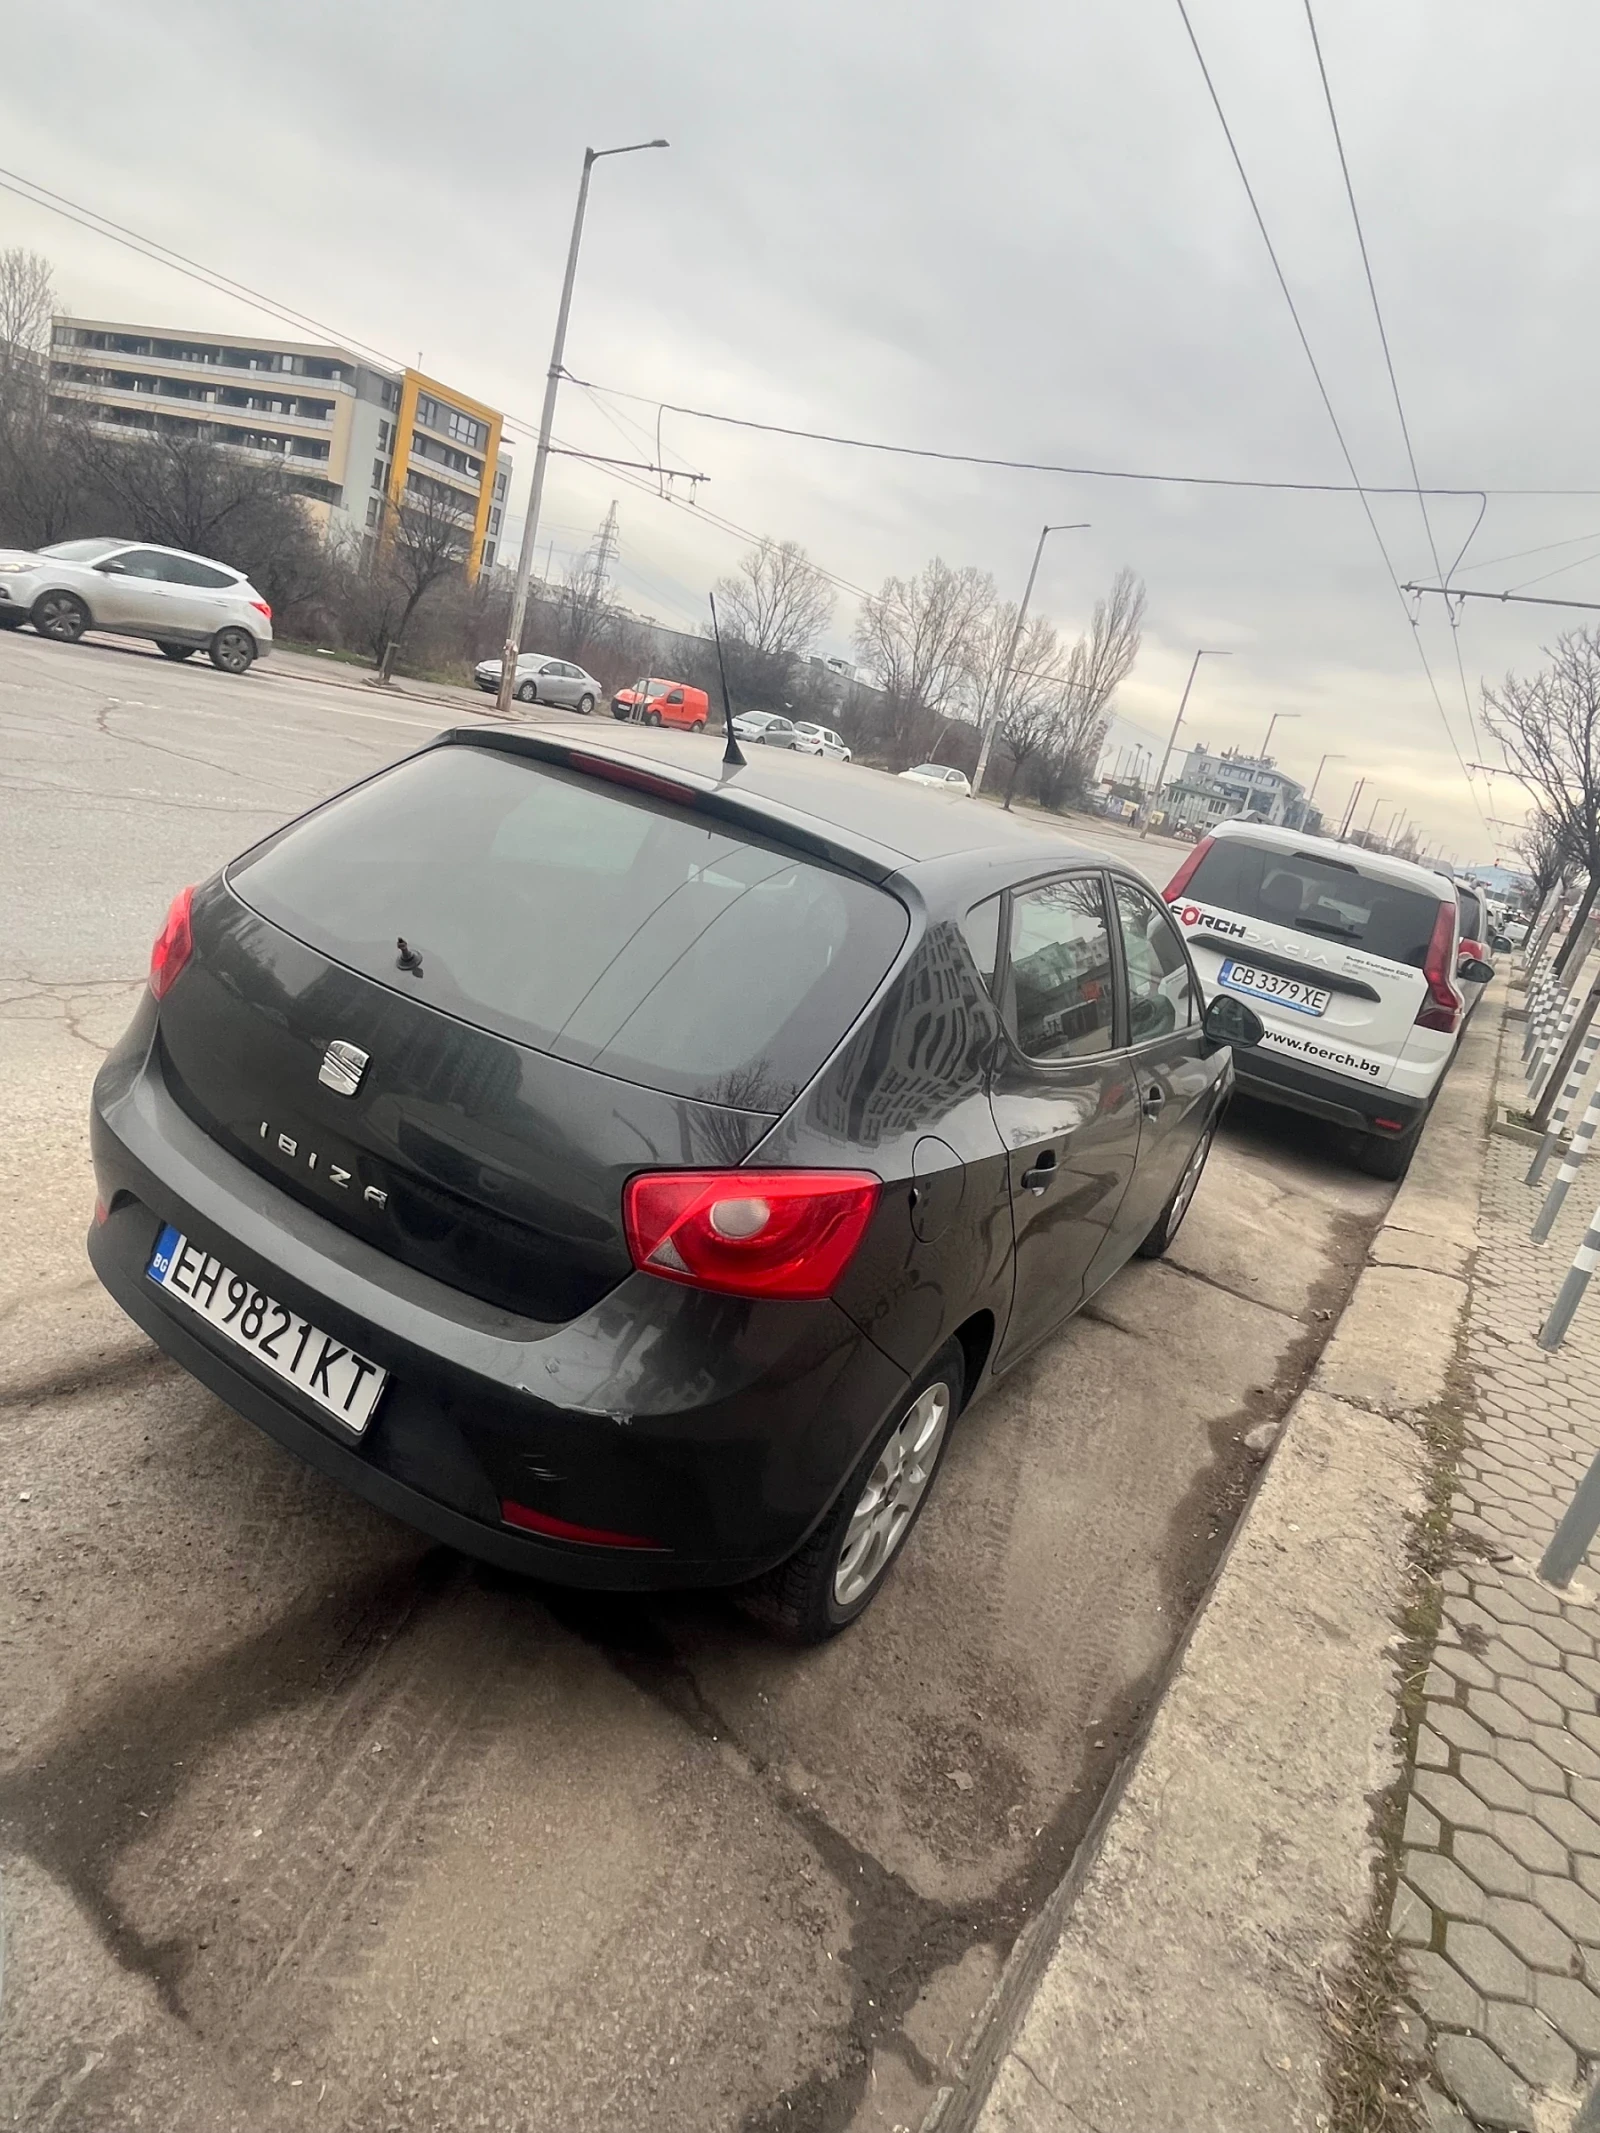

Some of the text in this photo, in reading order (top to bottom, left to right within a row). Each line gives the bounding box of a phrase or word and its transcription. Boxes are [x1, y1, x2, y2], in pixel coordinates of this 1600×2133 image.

[1245, 931, 1329, 966] DACIA
[1231, 966, 1255, 986] CB
[1255, 974, 1300, 999] 3379
[1300, 987, 1326, 1009] XE
[260, 1121, 388, 1210] IBIZA
[152, 1252, 169, 1274] BG
[221, 1275, 313, 1374] 9821
[308, 1337, 377, 1412] KT
